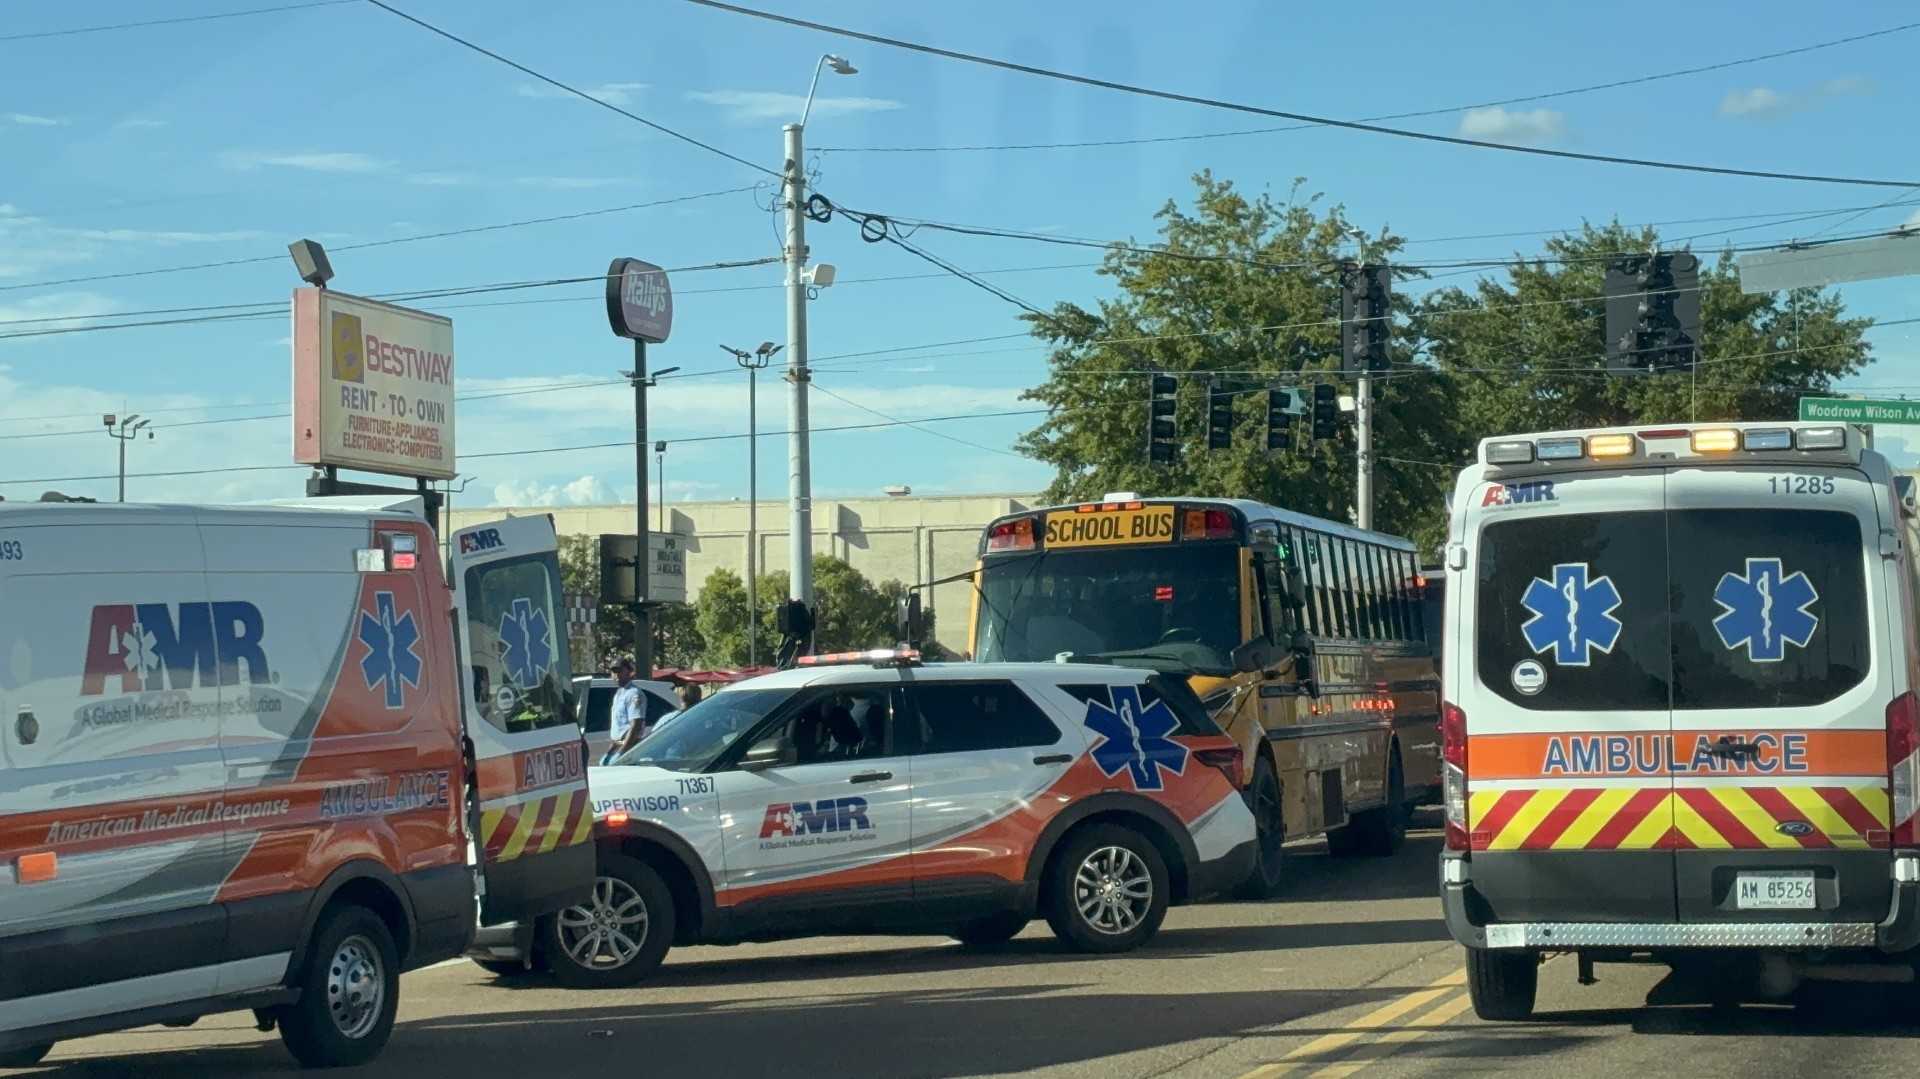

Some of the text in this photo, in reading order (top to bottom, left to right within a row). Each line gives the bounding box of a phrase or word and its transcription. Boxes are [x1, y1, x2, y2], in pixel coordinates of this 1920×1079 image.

[624, 269, 667, 318] Rally's
[365, 334, 452, 386] BESTWAY
[341, 384, 445, 424] RENT TO OWN
[1807, 404, 1862, 417] Woodrow
[1865, 405, 1903, 419] Wilson
[1481, 480, 1555, 507] AMR
[1767, 475, 1835, 495] 11285
[459, 528, 505, 555] AMR
[1046, 513, 1173, 543] SCHOOL BUS
[81, 600, 271, 696] AMR
[1543, 734, 1808, 774] AMBULANCE
[320, 771, 449, 819] AMBULANCE
[674, 776, 714, 795] 71367
[46, 798, 290, 844] American Medical Response
[592, 795, 680, 814] UPERVISOR
[759, 796, 870, 839] AMR
[1741, 881, 1813, 899] AM 85256
